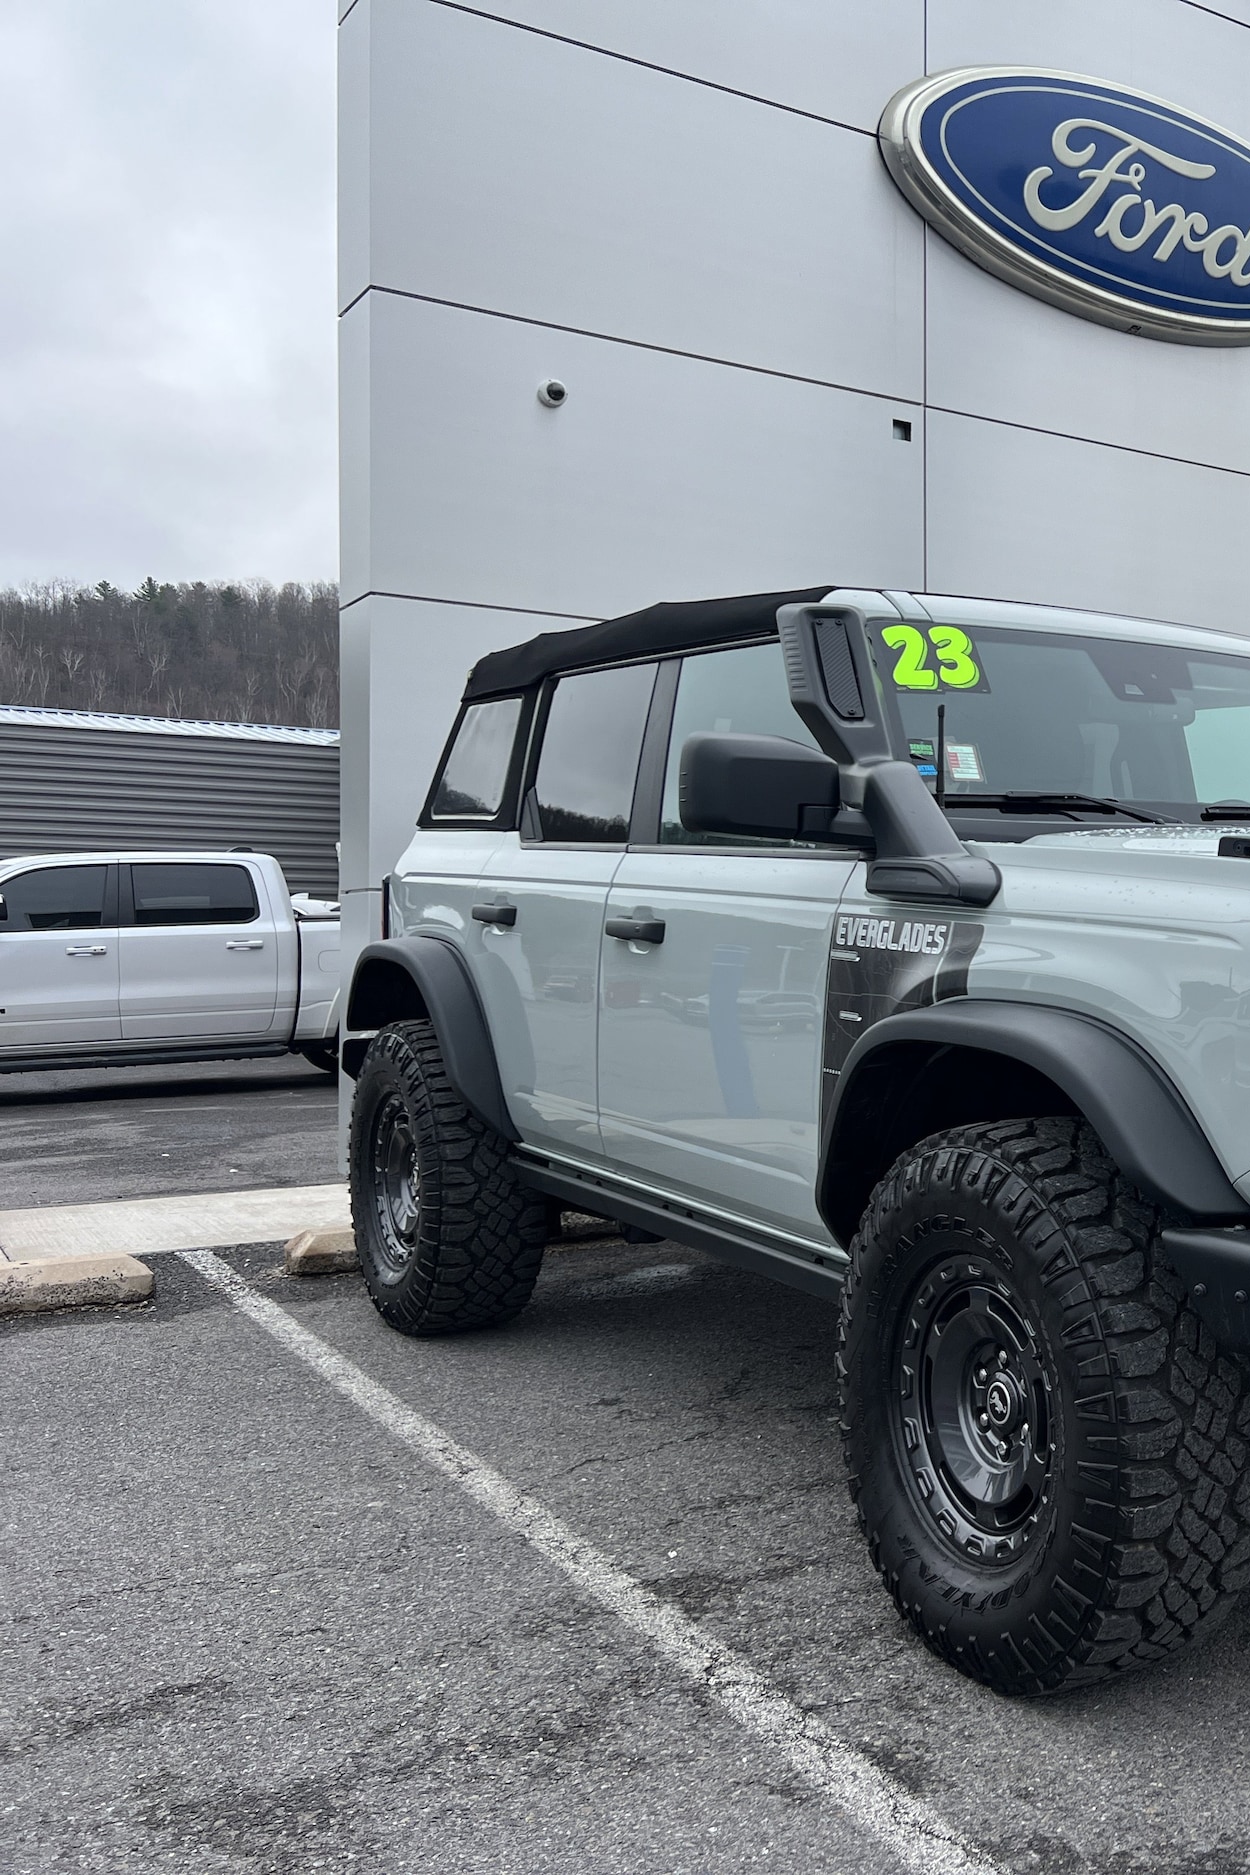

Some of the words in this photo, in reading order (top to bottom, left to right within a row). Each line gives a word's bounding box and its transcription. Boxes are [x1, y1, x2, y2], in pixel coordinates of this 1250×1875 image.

[881, 624, 980, 690] 23
[836, 916, 947, 955] EVERGLADES
[865, 1211, 1016, 1320] WRANGLER
